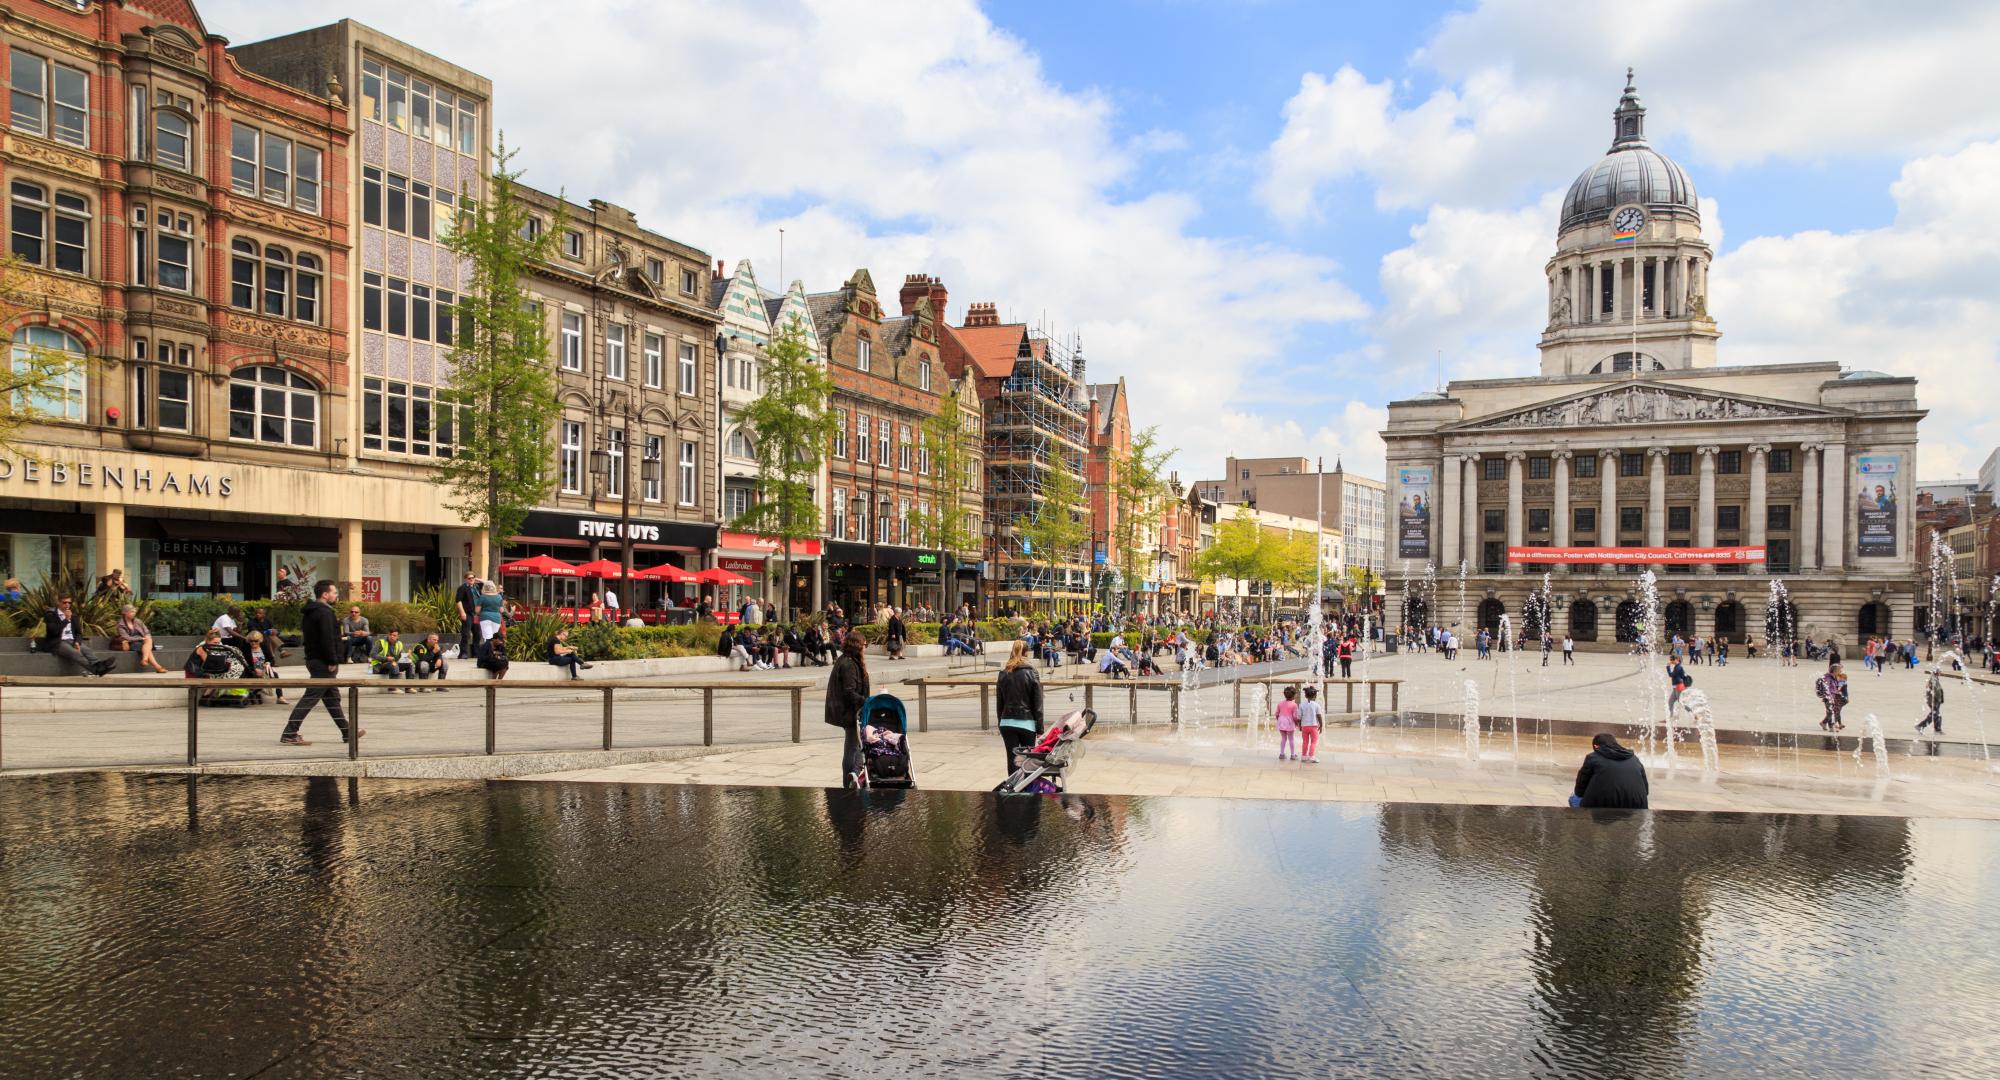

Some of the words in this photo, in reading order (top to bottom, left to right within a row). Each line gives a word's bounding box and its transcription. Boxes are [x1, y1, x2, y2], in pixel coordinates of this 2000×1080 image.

[579, 520, 615, 538] FIVE
[152, 542, 247, 555] DEBENHAMS
[725, 560, 752, 570] Ladbrokes
[918, 554, 936, 564] schuh
[362, 580, 380, 593] 10
